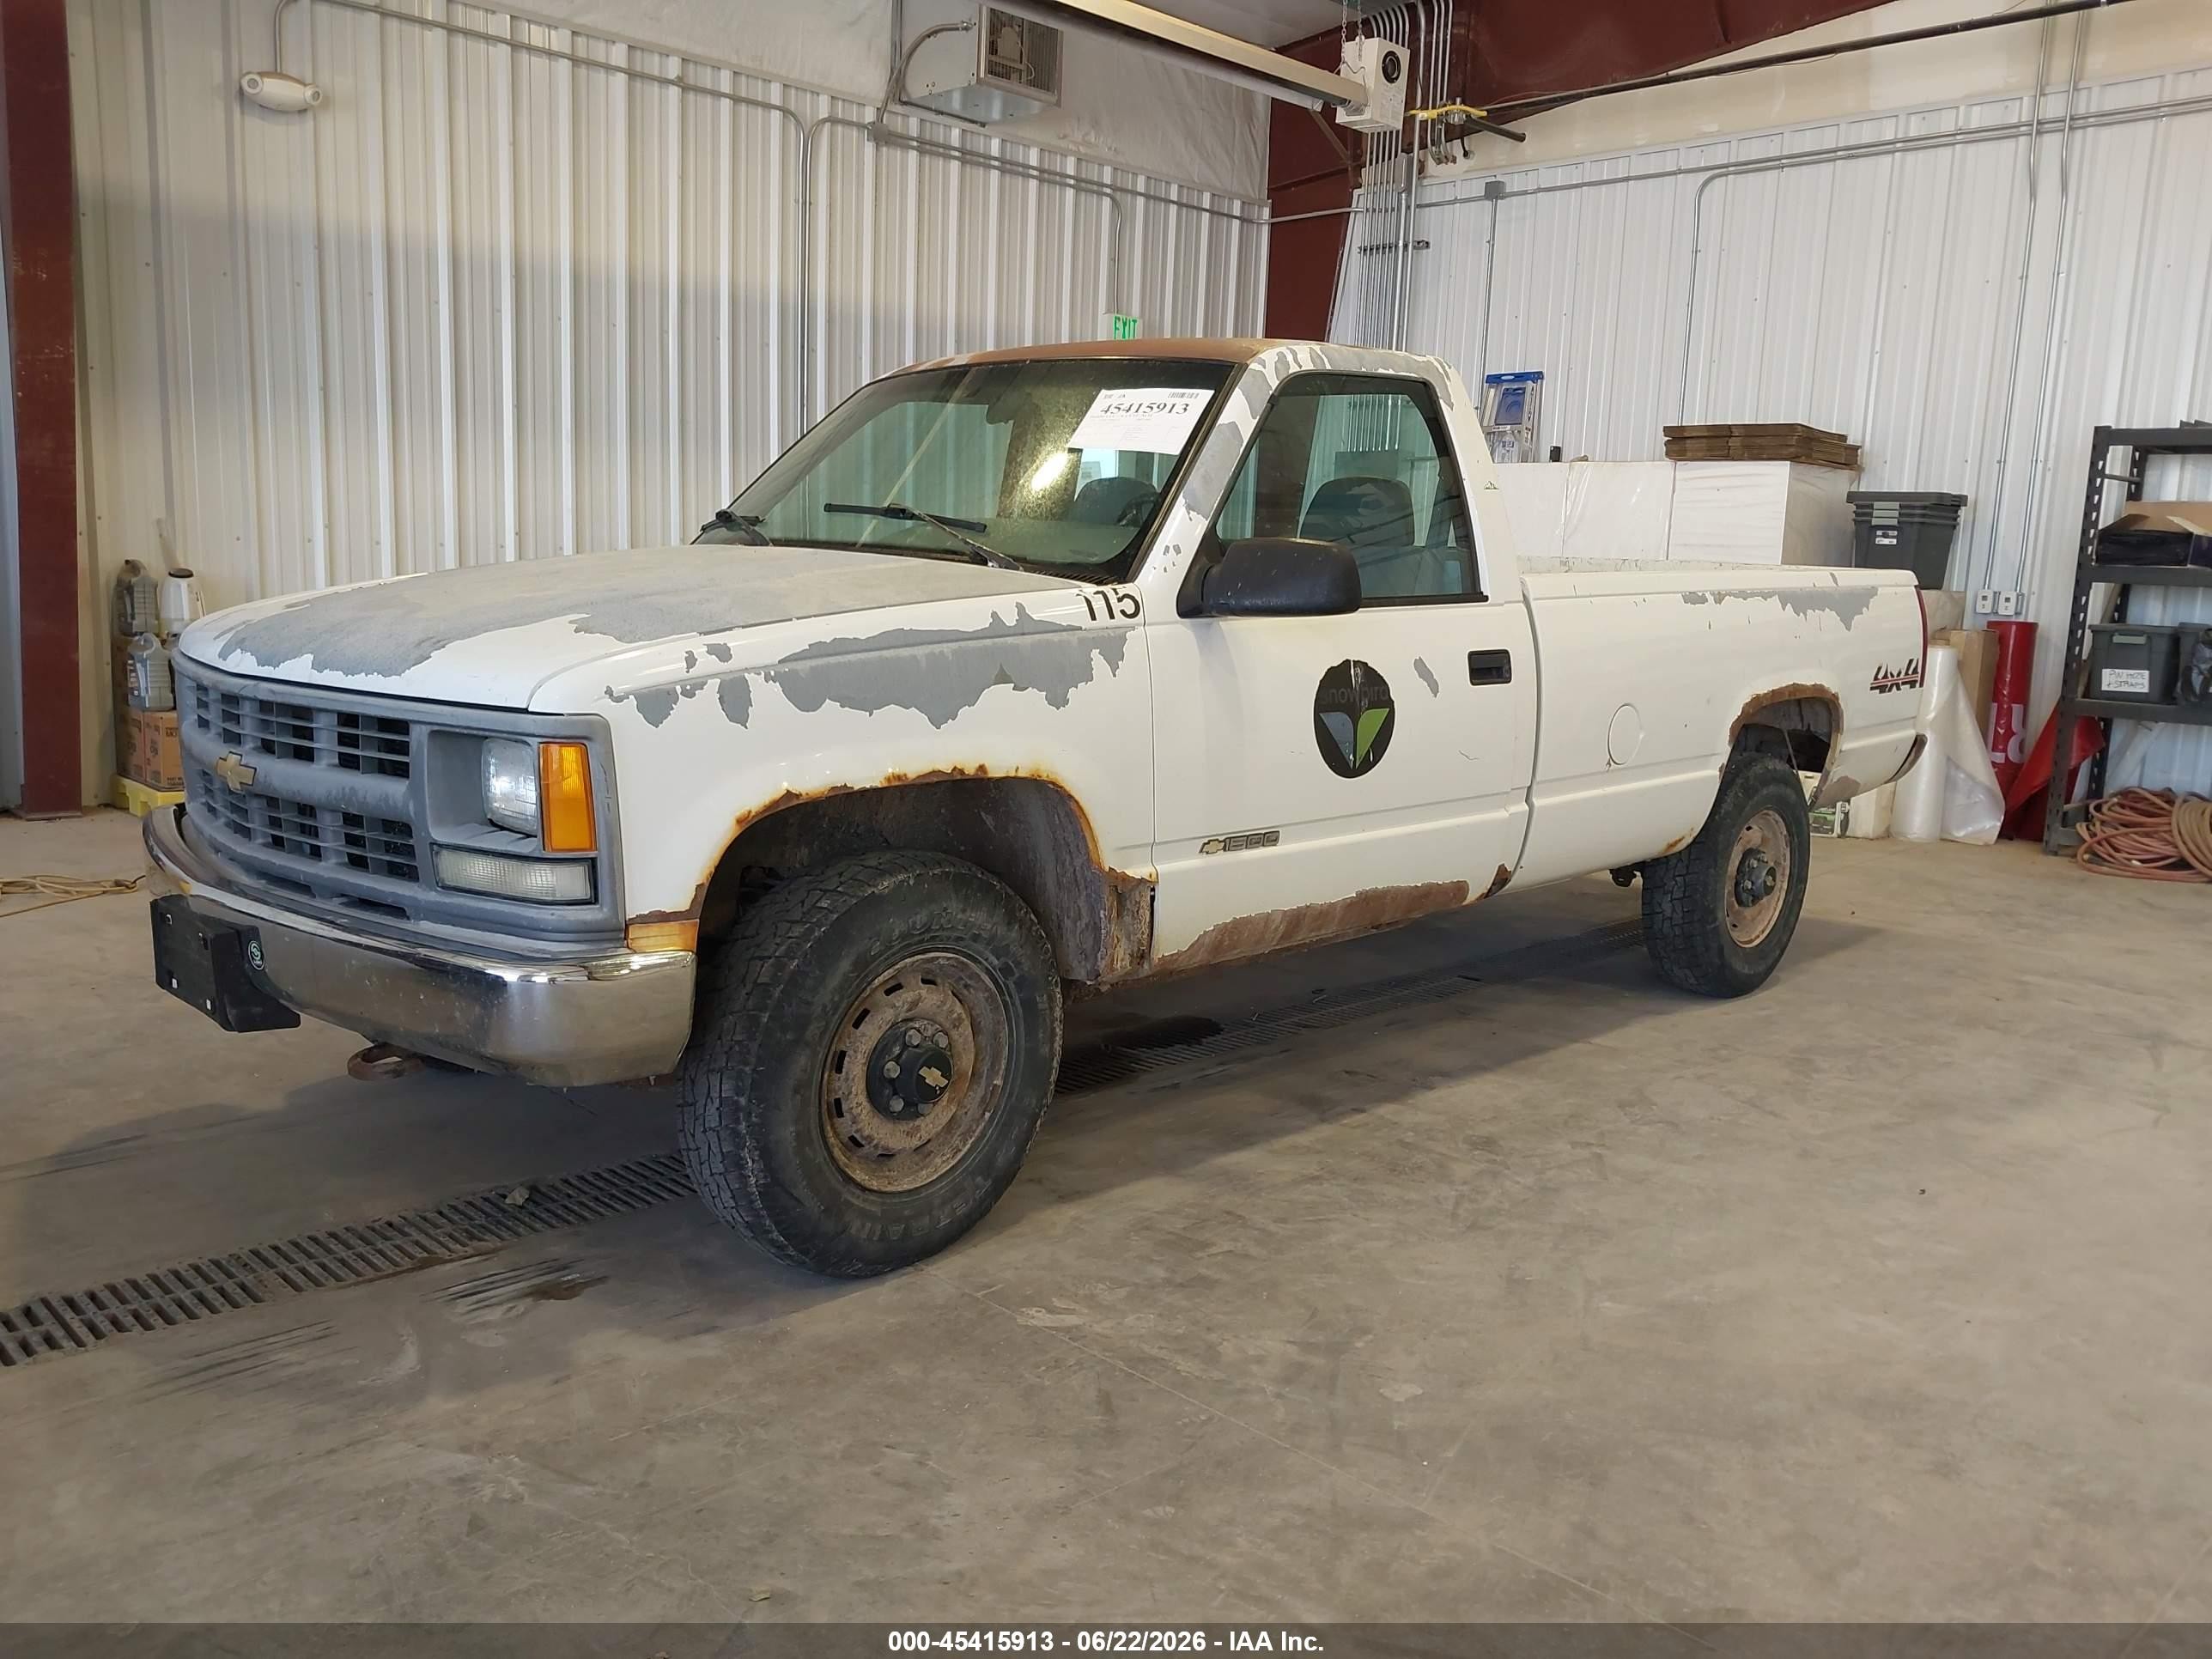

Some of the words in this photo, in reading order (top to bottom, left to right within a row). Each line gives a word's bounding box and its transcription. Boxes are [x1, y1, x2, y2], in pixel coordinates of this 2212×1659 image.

[1114, 315, 1138, 340] EXIT
[1100, 402, 1190, 415] 45415913
[1075, 587, 1140, 621] 115
